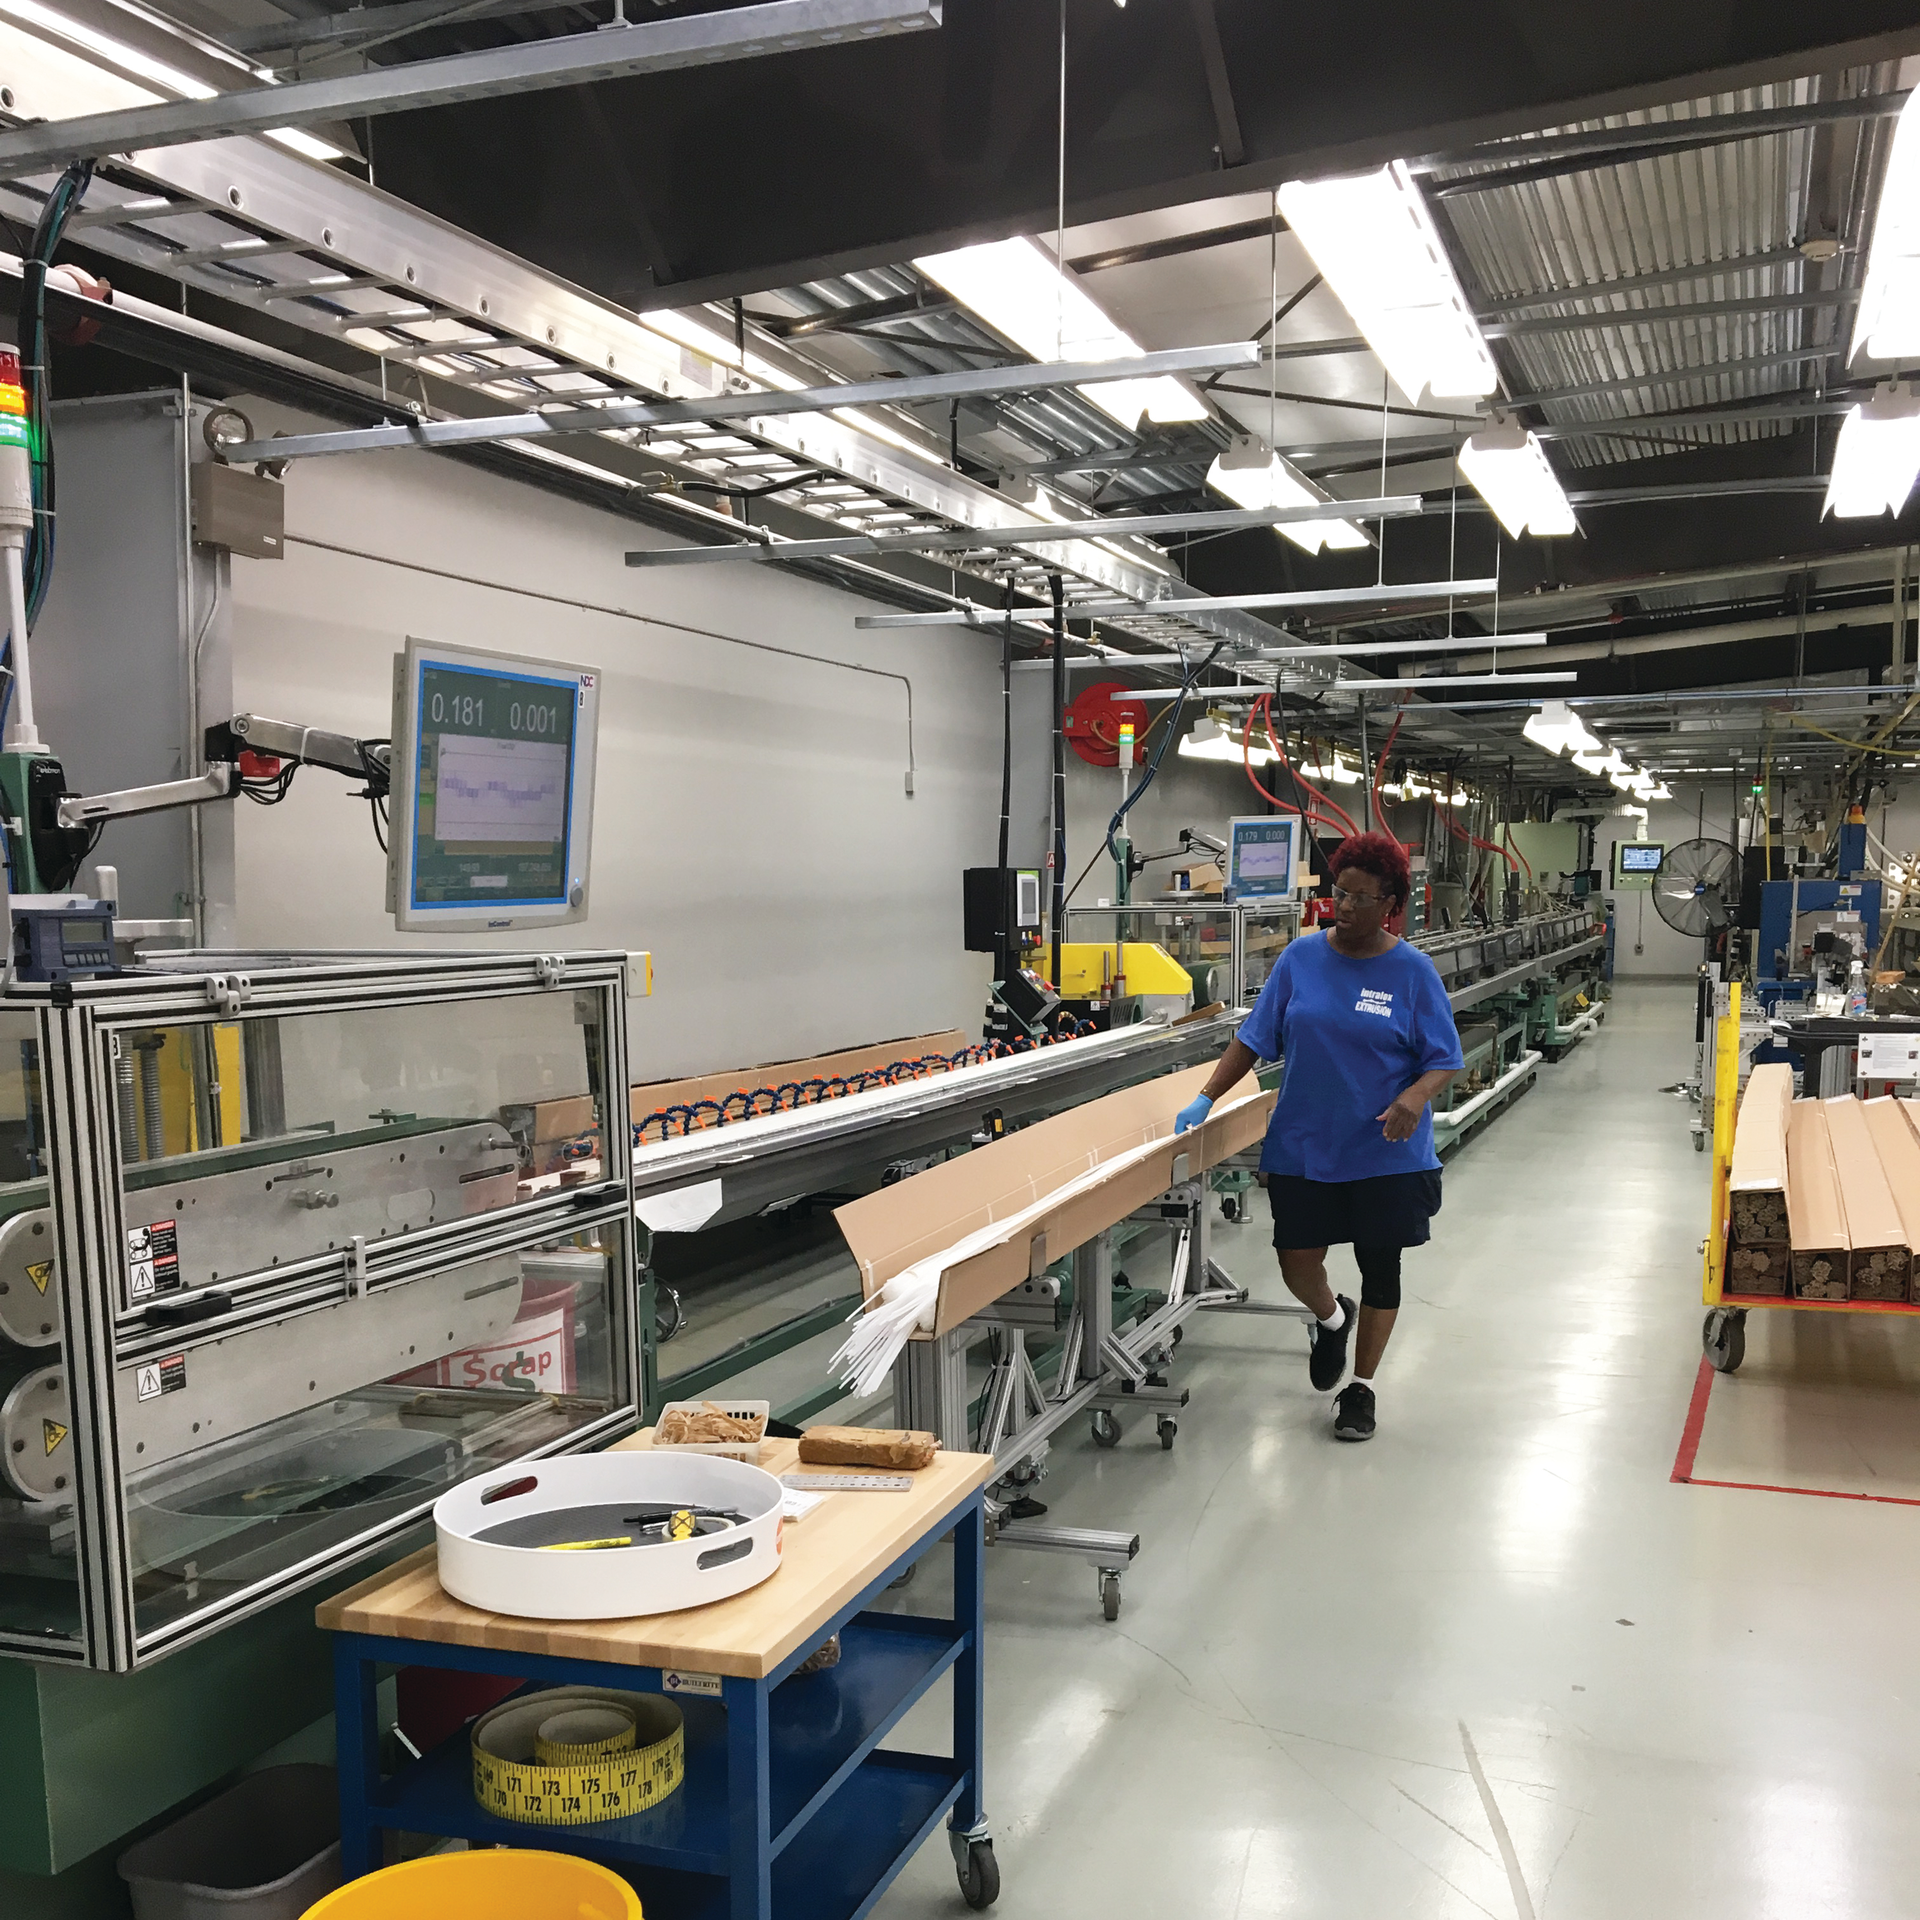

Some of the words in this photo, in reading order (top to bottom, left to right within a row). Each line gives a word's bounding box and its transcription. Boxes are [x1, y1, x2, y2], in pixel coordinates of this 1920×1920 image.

[580, 675, 594, 688] NDC
[431, 693, 483, 727] 0.181
[510, 702, 557, 734] 0.001
[1238, 831, 1258, 841] 0.179
[1266, 830, 1285, 840] 0.000
[1355, 1001, 1393, 1018] EXTRUSION
[507, 1776, 521, 1793] 171
[542, 1780, 560, 1796] 173
[581, 1778, 600, 1794] 175
[620, 1769, 637, 1788] 177
[652, 1757, 663, 1776] 179
[494, 1788, 507, 1806] 170
[524, 1795, 541, 1812] 172
[561, 1797, 580, 1812] 174
[601, 1791, 620, 1808] 176
[638, 1780, 652, 1799] 178
